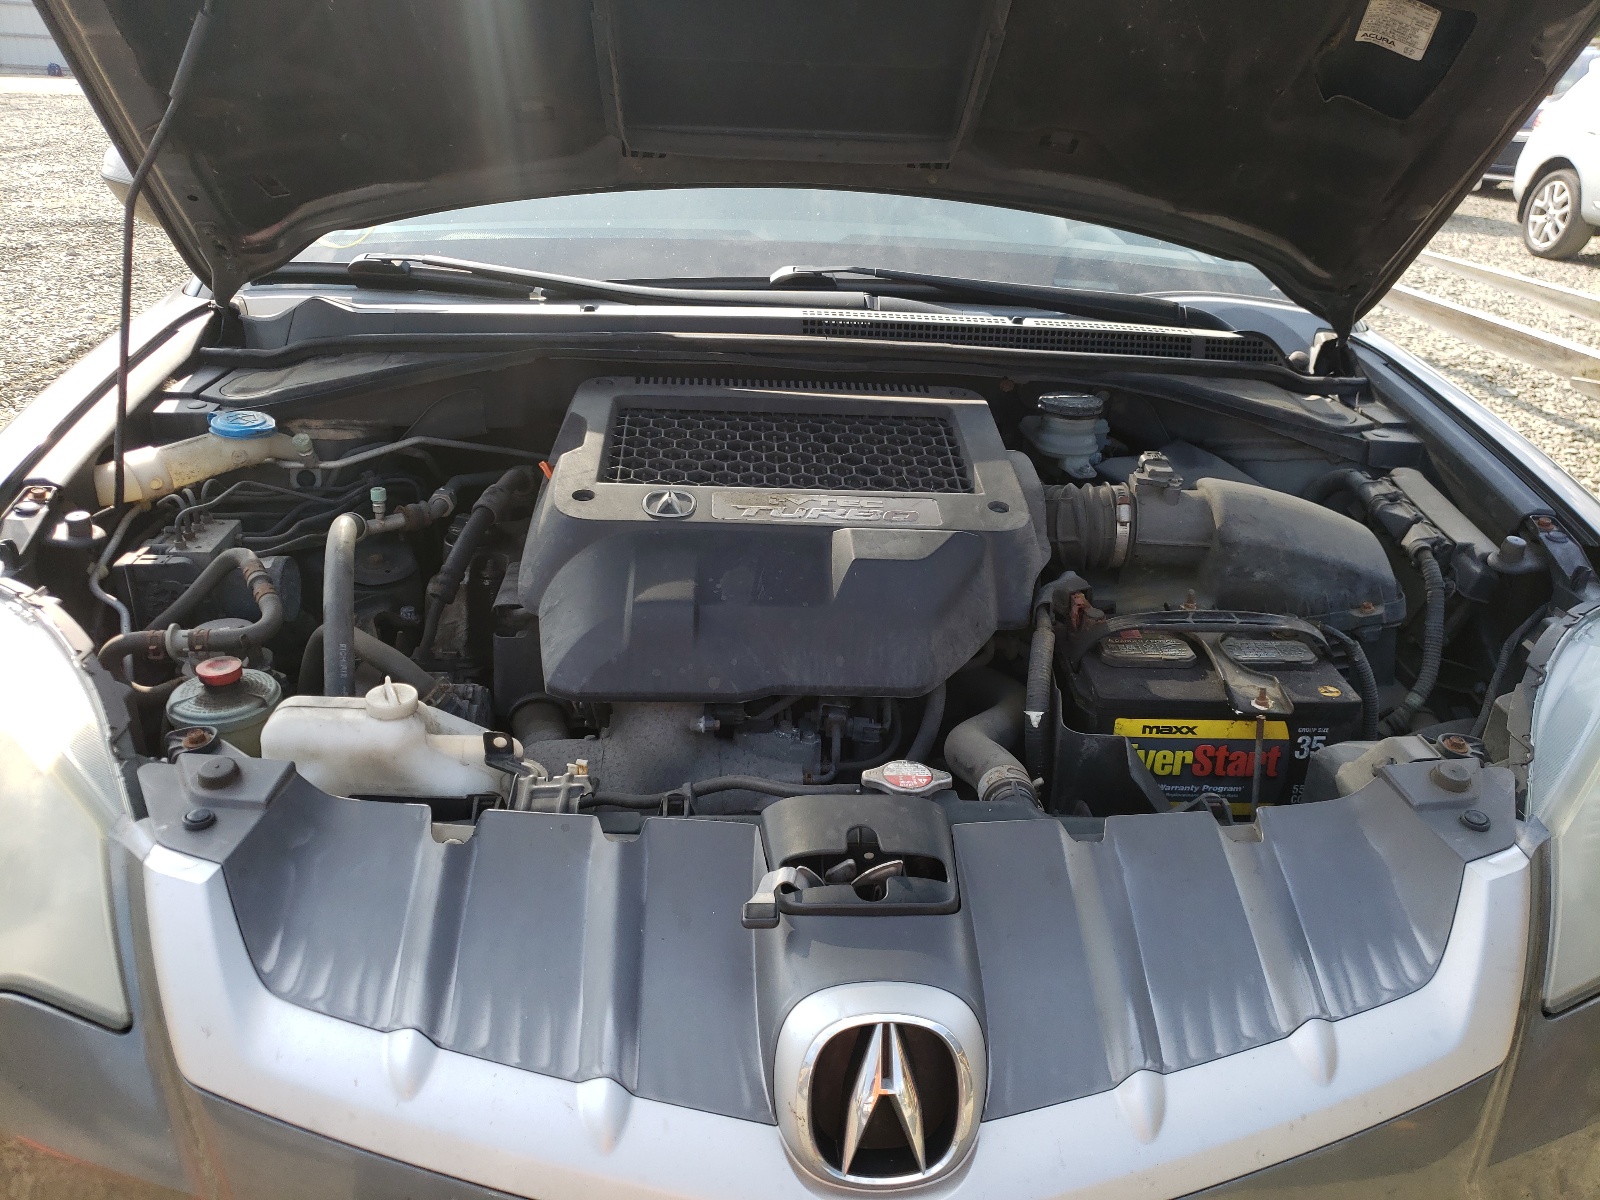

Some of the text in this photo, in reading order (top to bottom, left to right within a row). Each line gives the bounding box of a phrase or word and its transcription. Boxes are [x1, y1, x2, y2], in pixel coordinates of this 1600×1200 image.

[1361, 32, 1396, 47] ACURA
[730, 504, 920, 523] TURBO
[1142, 725, 1199, 736] maxx
[1131, 743, 1282, 778] verStart
